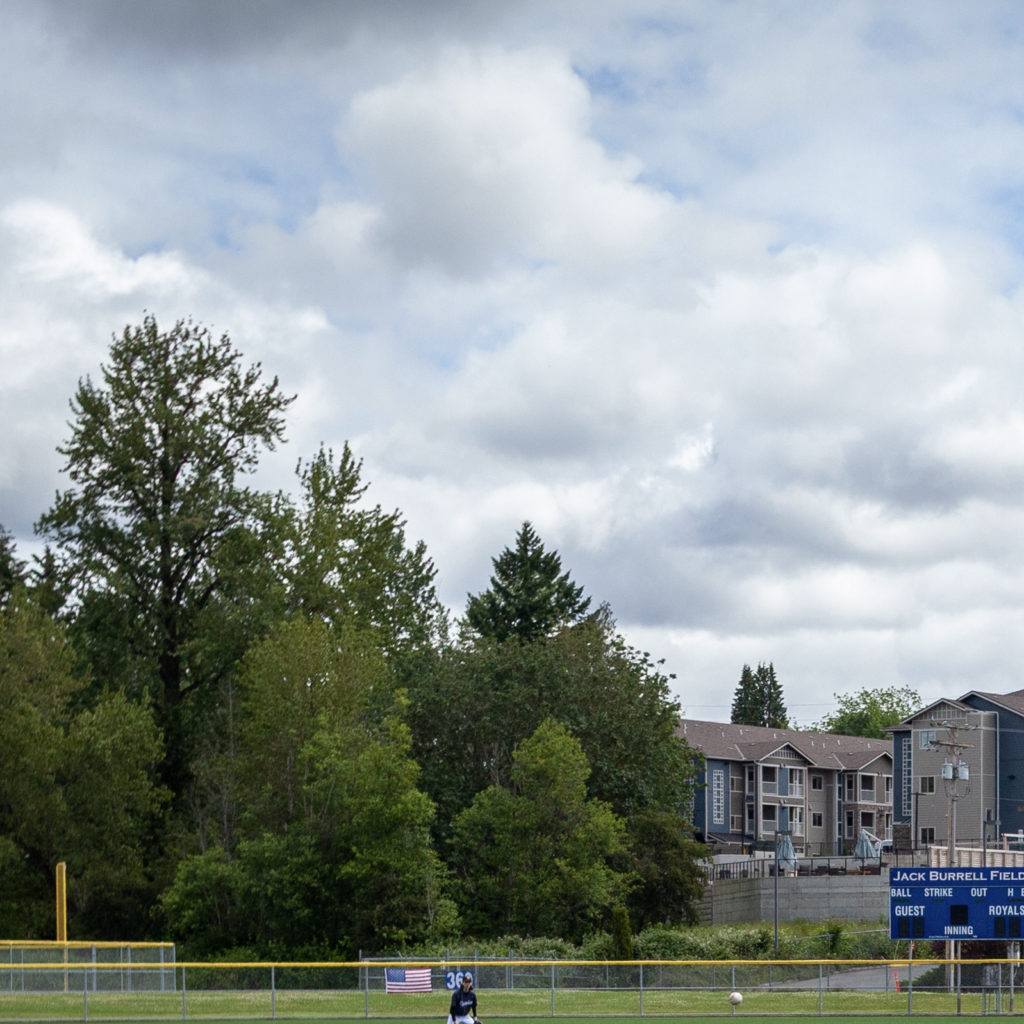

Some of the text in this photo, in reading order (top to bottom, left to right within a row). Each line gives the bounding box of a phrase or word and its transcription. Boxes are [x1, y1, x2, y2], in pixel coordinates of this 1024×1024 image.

[891, 888, 912, 897] BALL
[924, 888, 953, 897] STRIKE
[970, 887, 988, 897] OUT
[1007, 887, 1014, 897] H
[895, 905, 925, 916] GUEST
[944, 926, 974, 935] INNING
